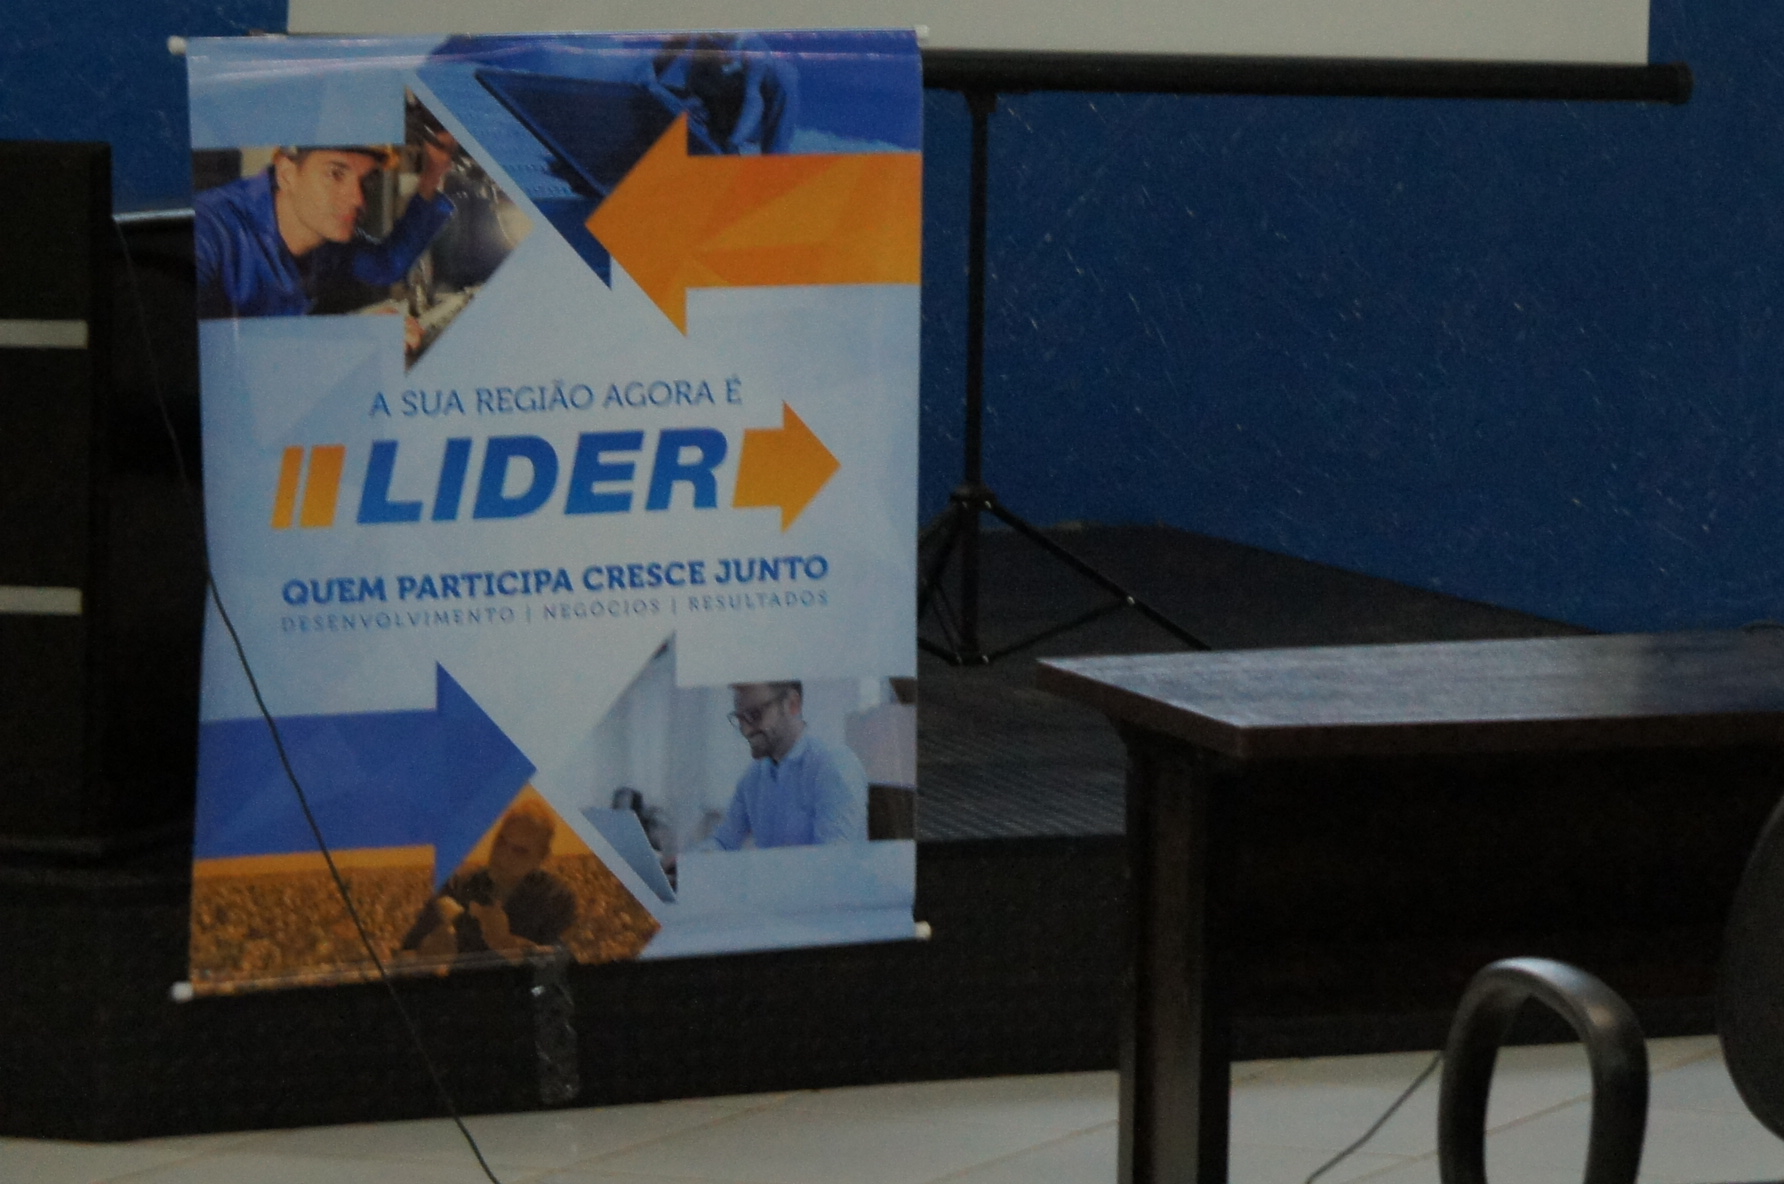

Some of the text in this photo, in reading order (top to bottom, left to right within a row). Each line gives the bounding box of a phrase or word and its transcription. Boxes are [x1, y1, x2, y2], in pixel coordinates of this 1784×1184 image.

[371, 376, 742, 417] A SUA REGIÃO AGORA É
[357, 427, 729, 525] LIDER
[281, 554, 830, 607] QUEM PARTICIPA CRESCE JUNTO
[281, 607, 516, 632] DESENVOLVIMENTO
[543, 595, 661, 620] NEGÓCIOS
[688, 590, 830, 612] RESULTADOS
